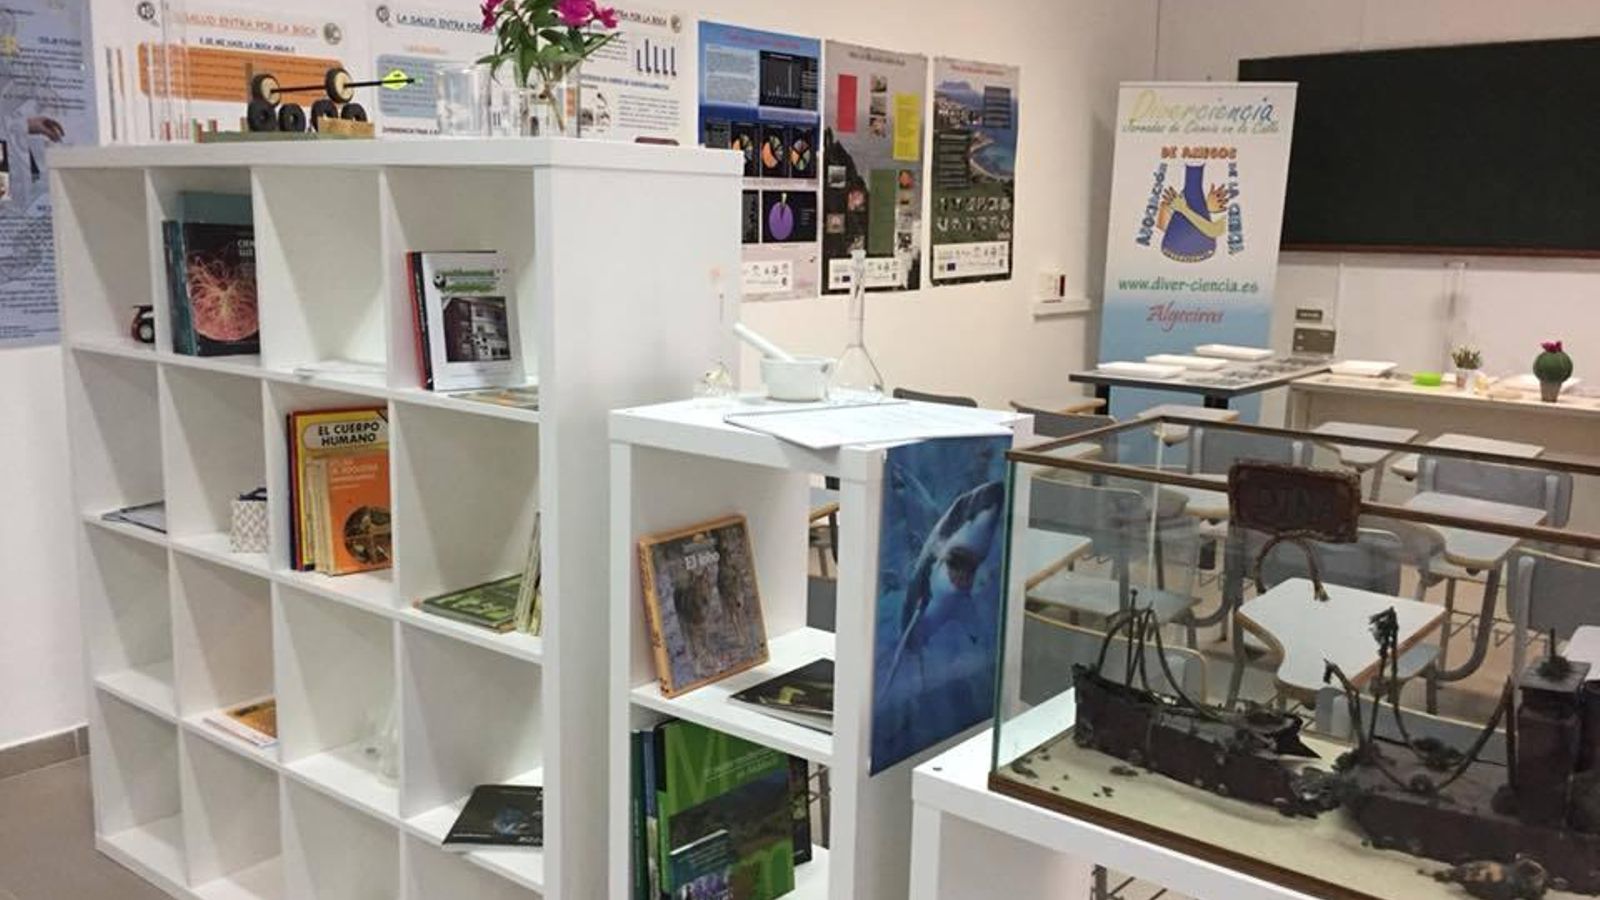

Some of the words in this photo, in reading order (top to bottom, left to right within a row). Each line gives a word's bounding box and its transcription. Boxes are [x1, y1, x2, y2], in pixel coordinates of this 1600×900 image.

[396, 13, 408, 24] LA
[410, 15, 437, 28] SALUD
[439, 18, 464, 30] ENTRA
[1130, 89, 1274, 121] Diverciencia
[1182, 146, 1237, 159] AMIGOS
[1118, 276, 1259, 292] www.diver-ciencia.es
[317, 425, 330, 437] EL
[334, 421, 380, 435] CUERPO
[321, 432, 377, 447] HUMANO
